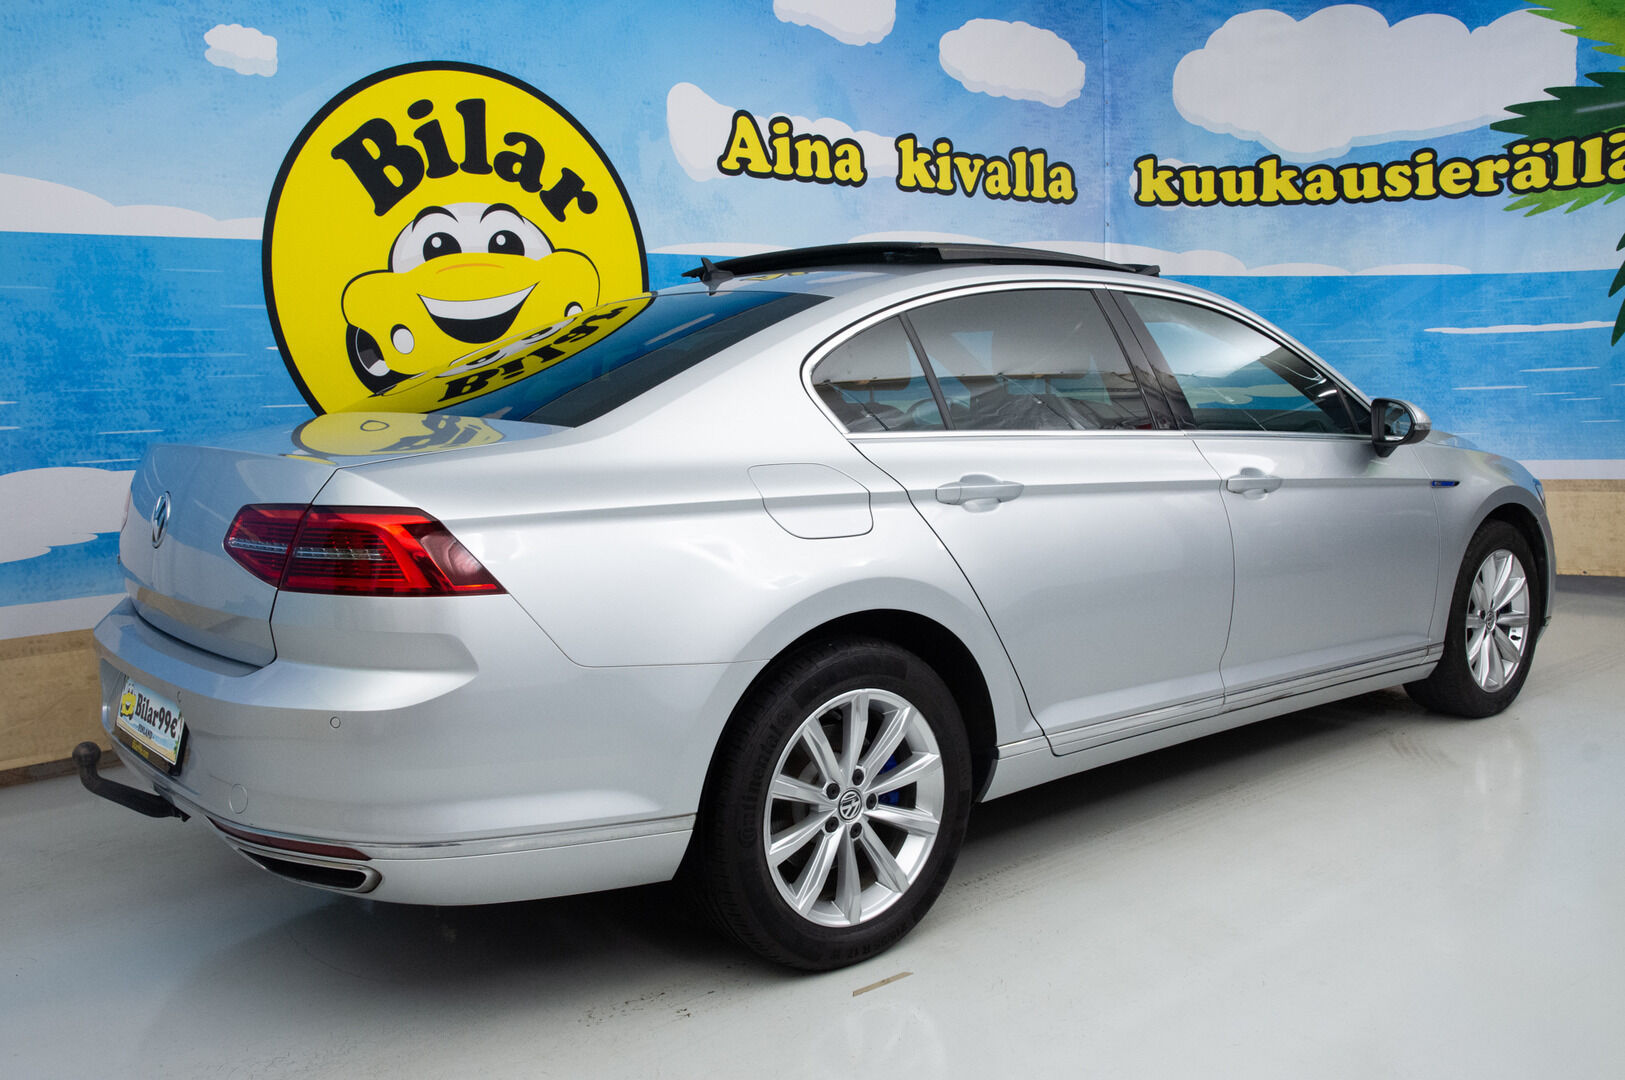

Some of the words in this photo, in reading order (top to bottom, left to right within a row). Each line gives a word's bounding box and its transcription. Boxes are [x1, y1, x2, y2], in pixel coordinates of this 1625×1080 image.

[331, 98, 598, 222] Bilar
[718, 110, 867, 187] Aina
[895, 134, 1078, 204] kivalla
